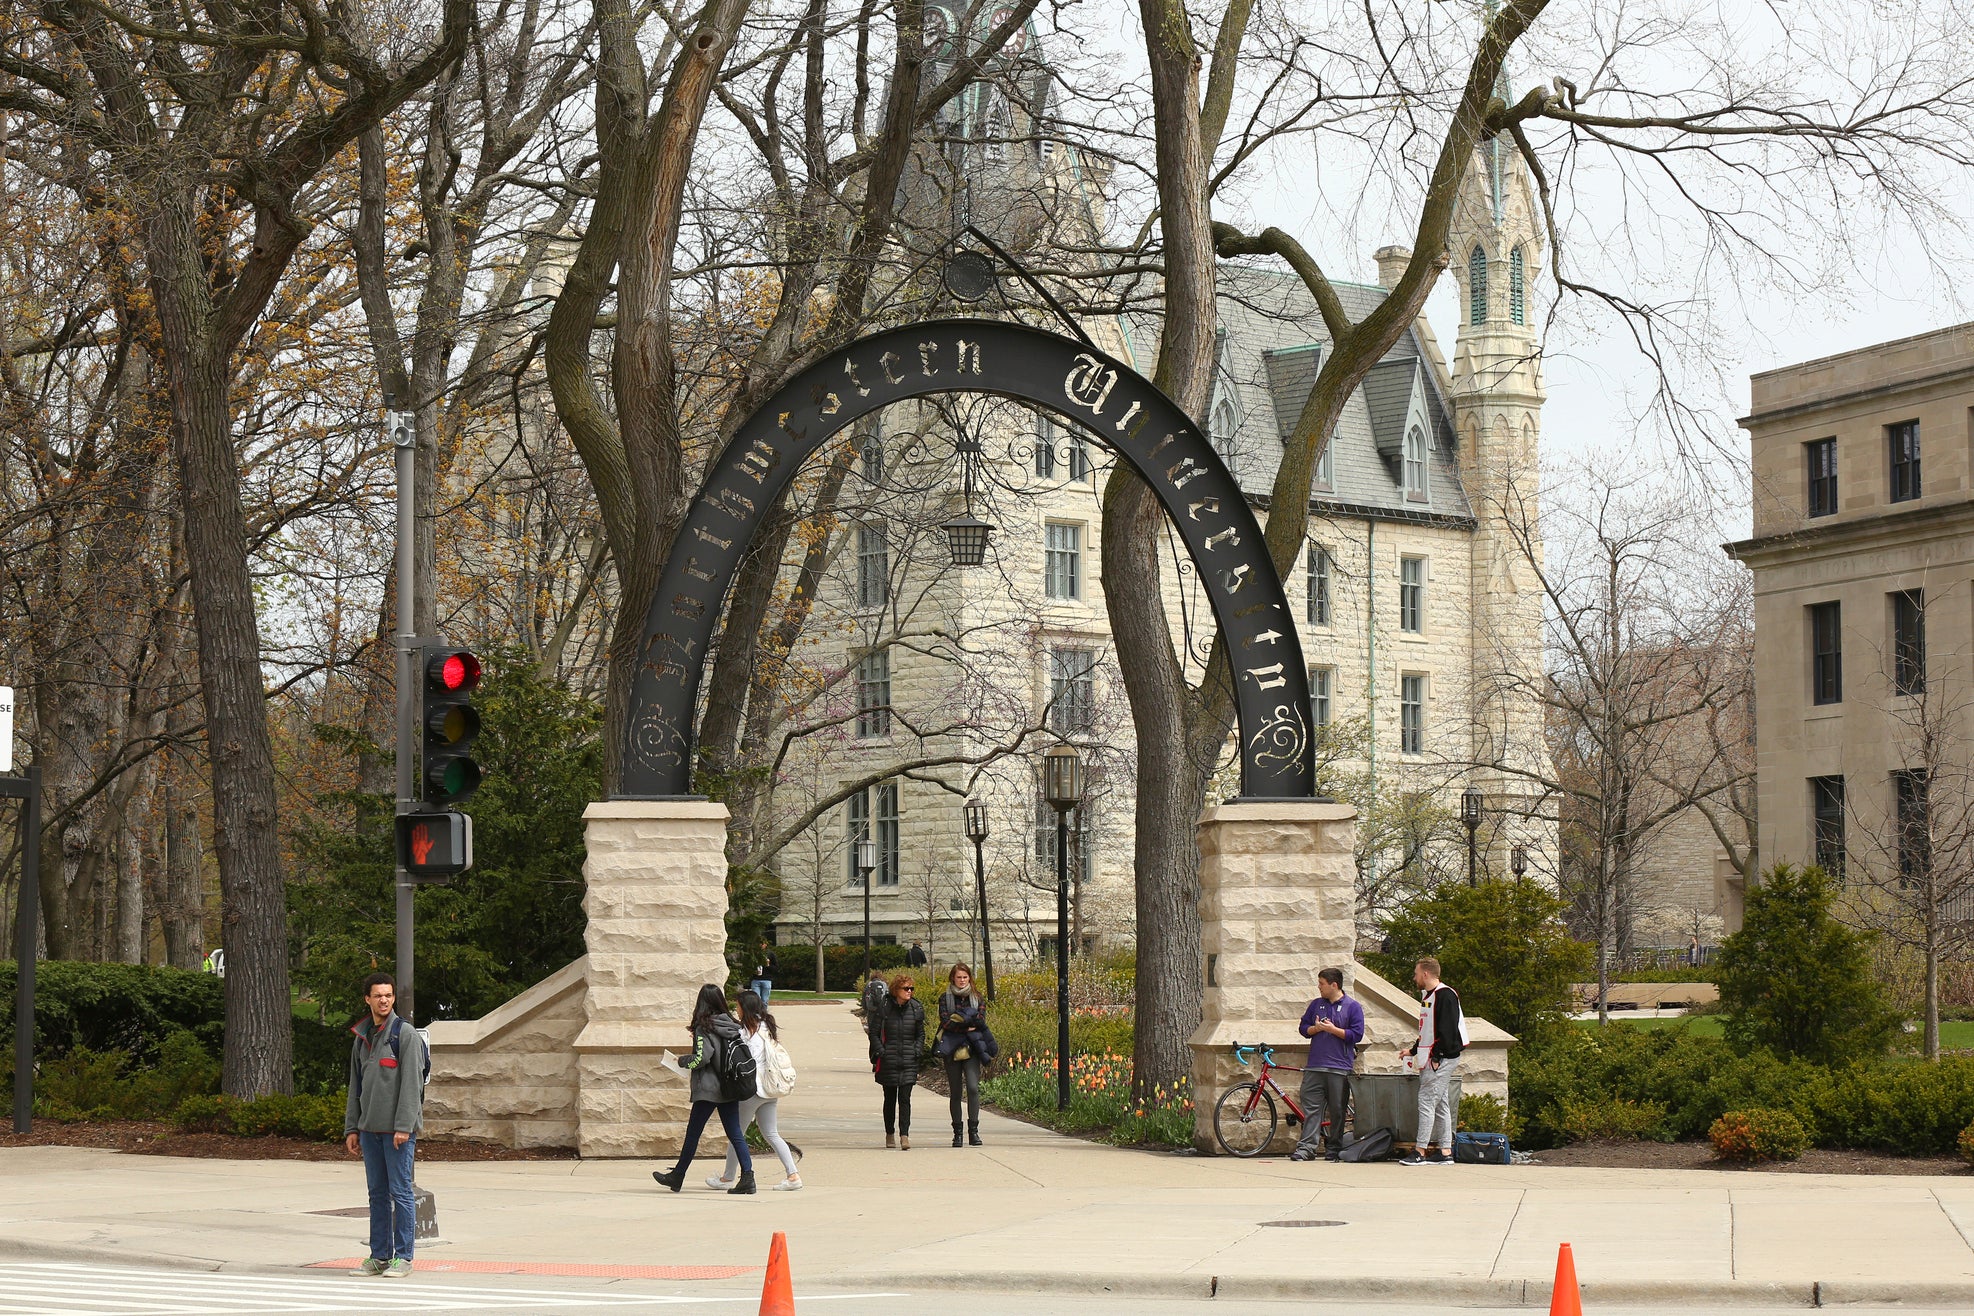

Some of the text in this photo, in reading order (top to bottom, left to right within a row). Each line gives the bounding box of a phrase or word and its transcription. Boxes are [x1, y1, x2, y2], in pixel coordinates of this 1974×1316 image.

[640, 339, 1288, 692] Northwestern University
[1800, 557, 1857, 580] HISTORY
